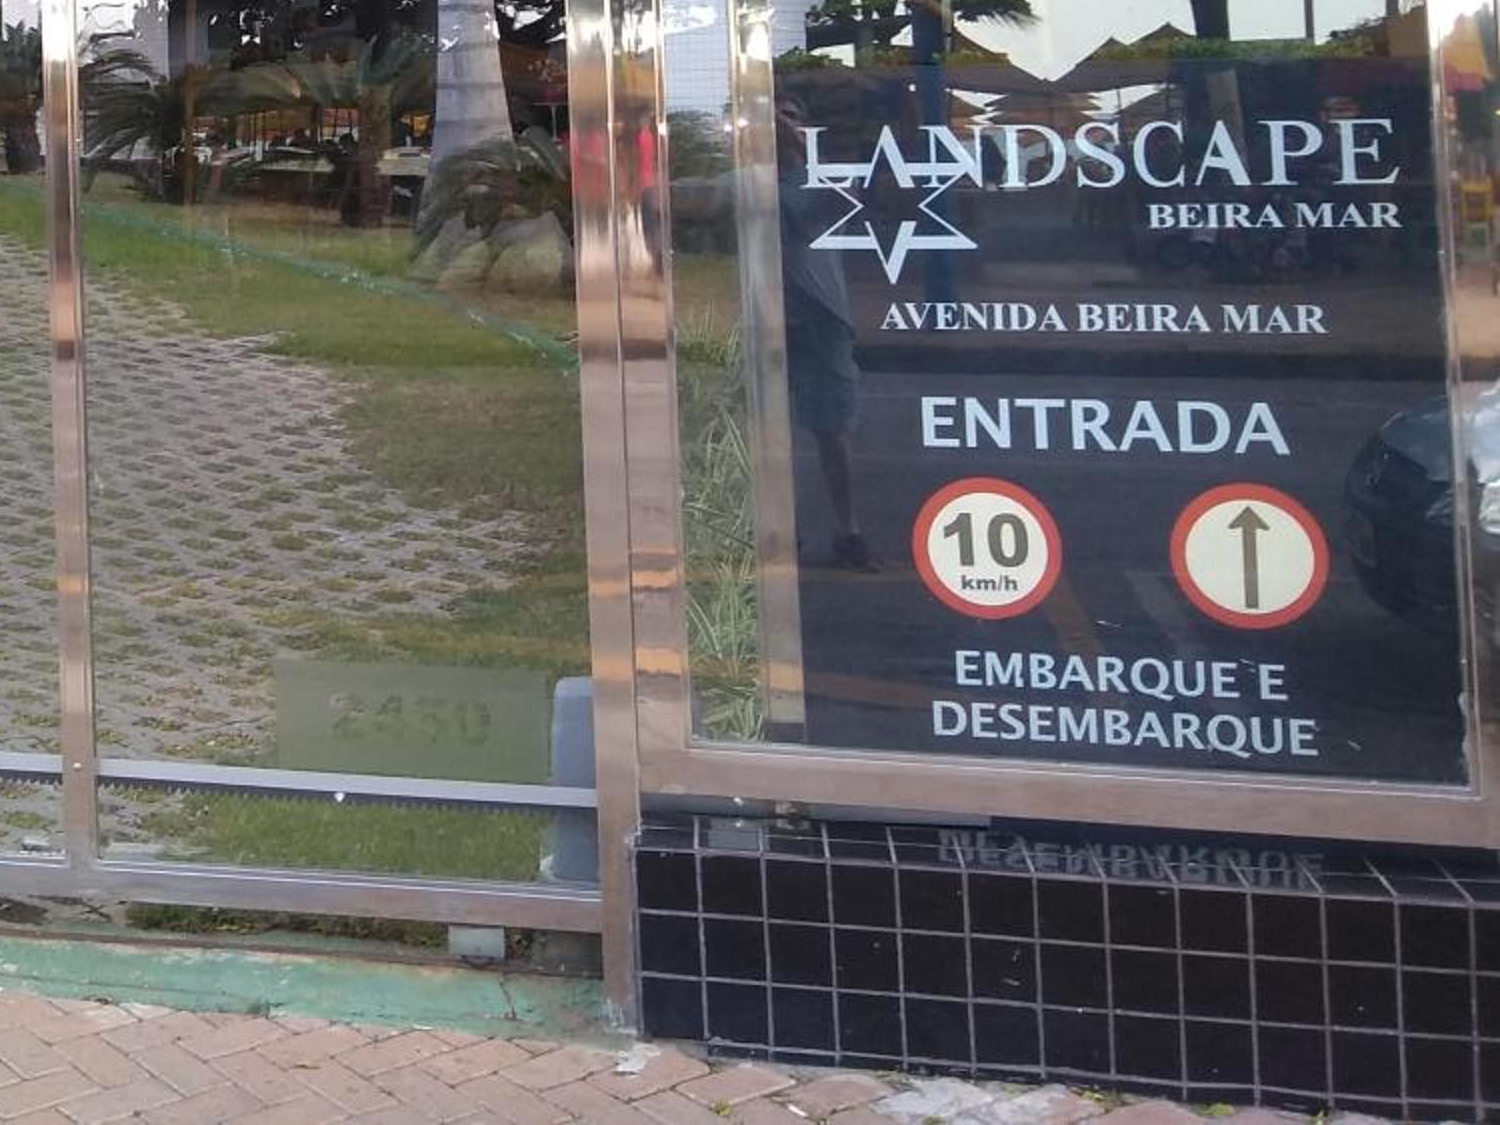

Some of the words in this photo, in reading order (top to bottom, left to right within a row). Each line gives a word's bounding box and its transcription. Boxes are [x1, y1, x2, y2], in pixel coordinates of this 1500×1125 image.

[800, 118, 1398, 190] LANDSCAPE
[1148, 202, 1285, 230] BEIRA
[1294, 201, 1402, 230] MAR
[880, 301, 1068, 333] AVENIDA
[1076, 302, 1212, 334] BEIRA
[1222, 303, 1329, 335] MAR
[920, 395, 1291, 456] ENTRADA
[941, 511, 1030, 570] 10
[960, 573, 1019, 594] km/h
[954, 649, 1238, 702] EMBARQUE
[1258, 662, 1289, 701] E
[931, 701, 1319, 757] DESEMBARQUE
